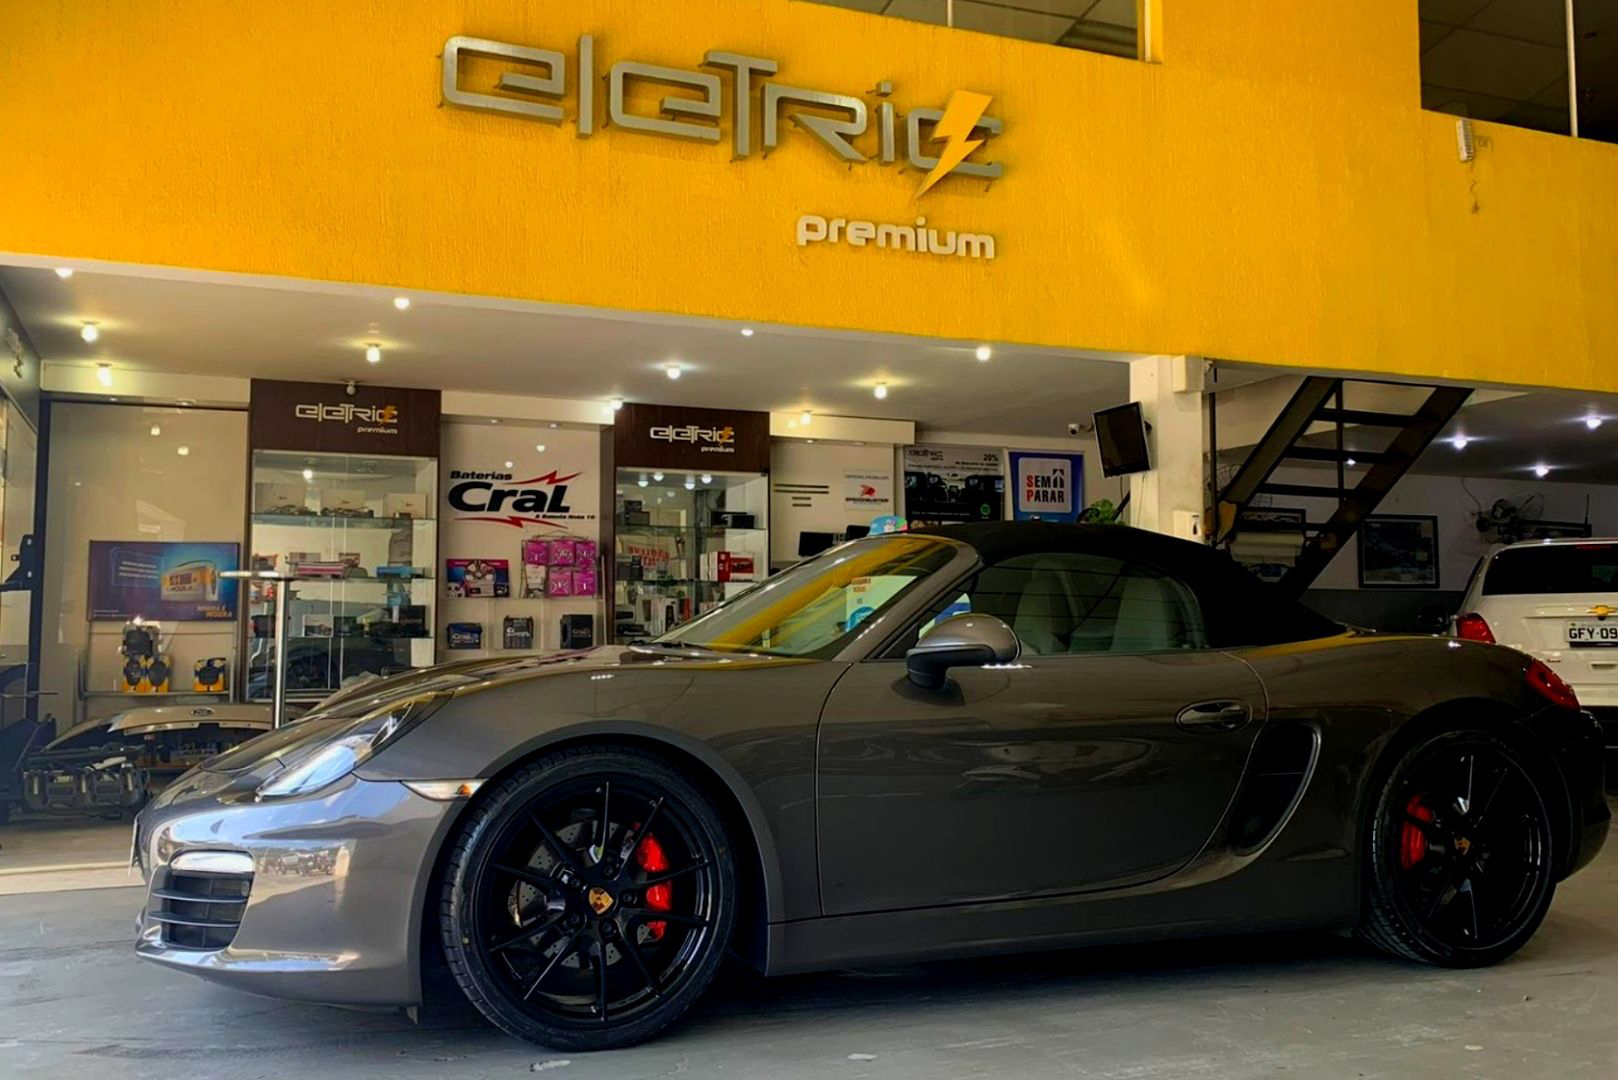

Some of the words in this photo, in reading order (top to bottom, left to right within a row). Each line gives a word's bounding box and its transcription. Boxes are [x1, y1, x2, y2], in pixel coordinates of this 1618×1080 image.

[796, 214, 996, 260] premium
[357, 426, 398, 434] premium
[450, 470, 513, 480] Baterias
[1026, 474, 1051, 488] SEM
[1026, 489, 1065, 503] PARAR
